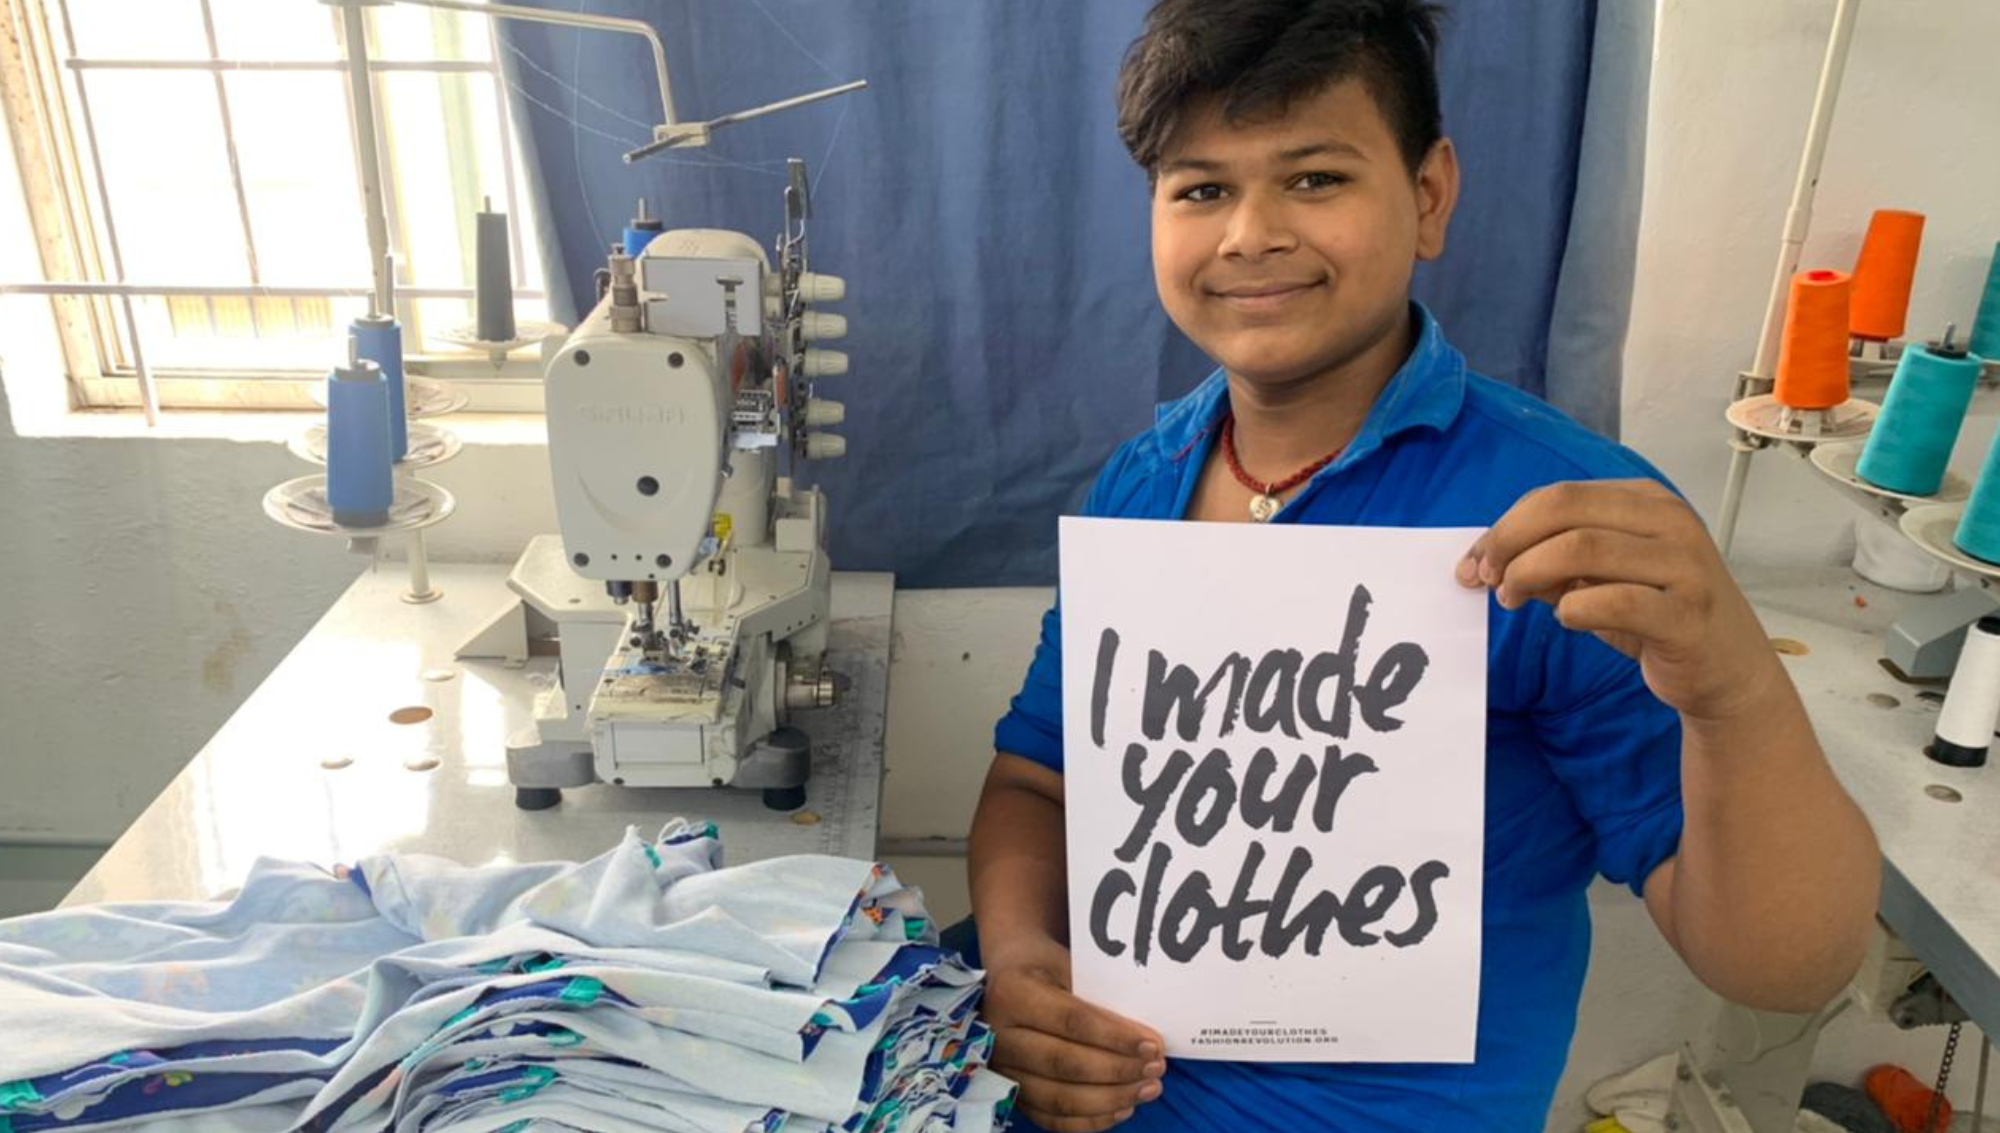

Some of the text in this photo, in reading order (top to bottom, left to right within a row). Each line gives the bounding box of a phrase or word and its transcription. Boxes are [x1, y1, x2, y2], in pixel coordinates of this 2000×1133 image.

[1091, 584, 1429, 749] I made
[1113, 743, 1380, 863] your
[1089, 841, 1450, 967] clothes
[1190, 1036, 1339, 1045] FASHIONREVOLUTION.ORG
[1200, 1027, 1328, 1036] #IMADEYOURCLOTHES
